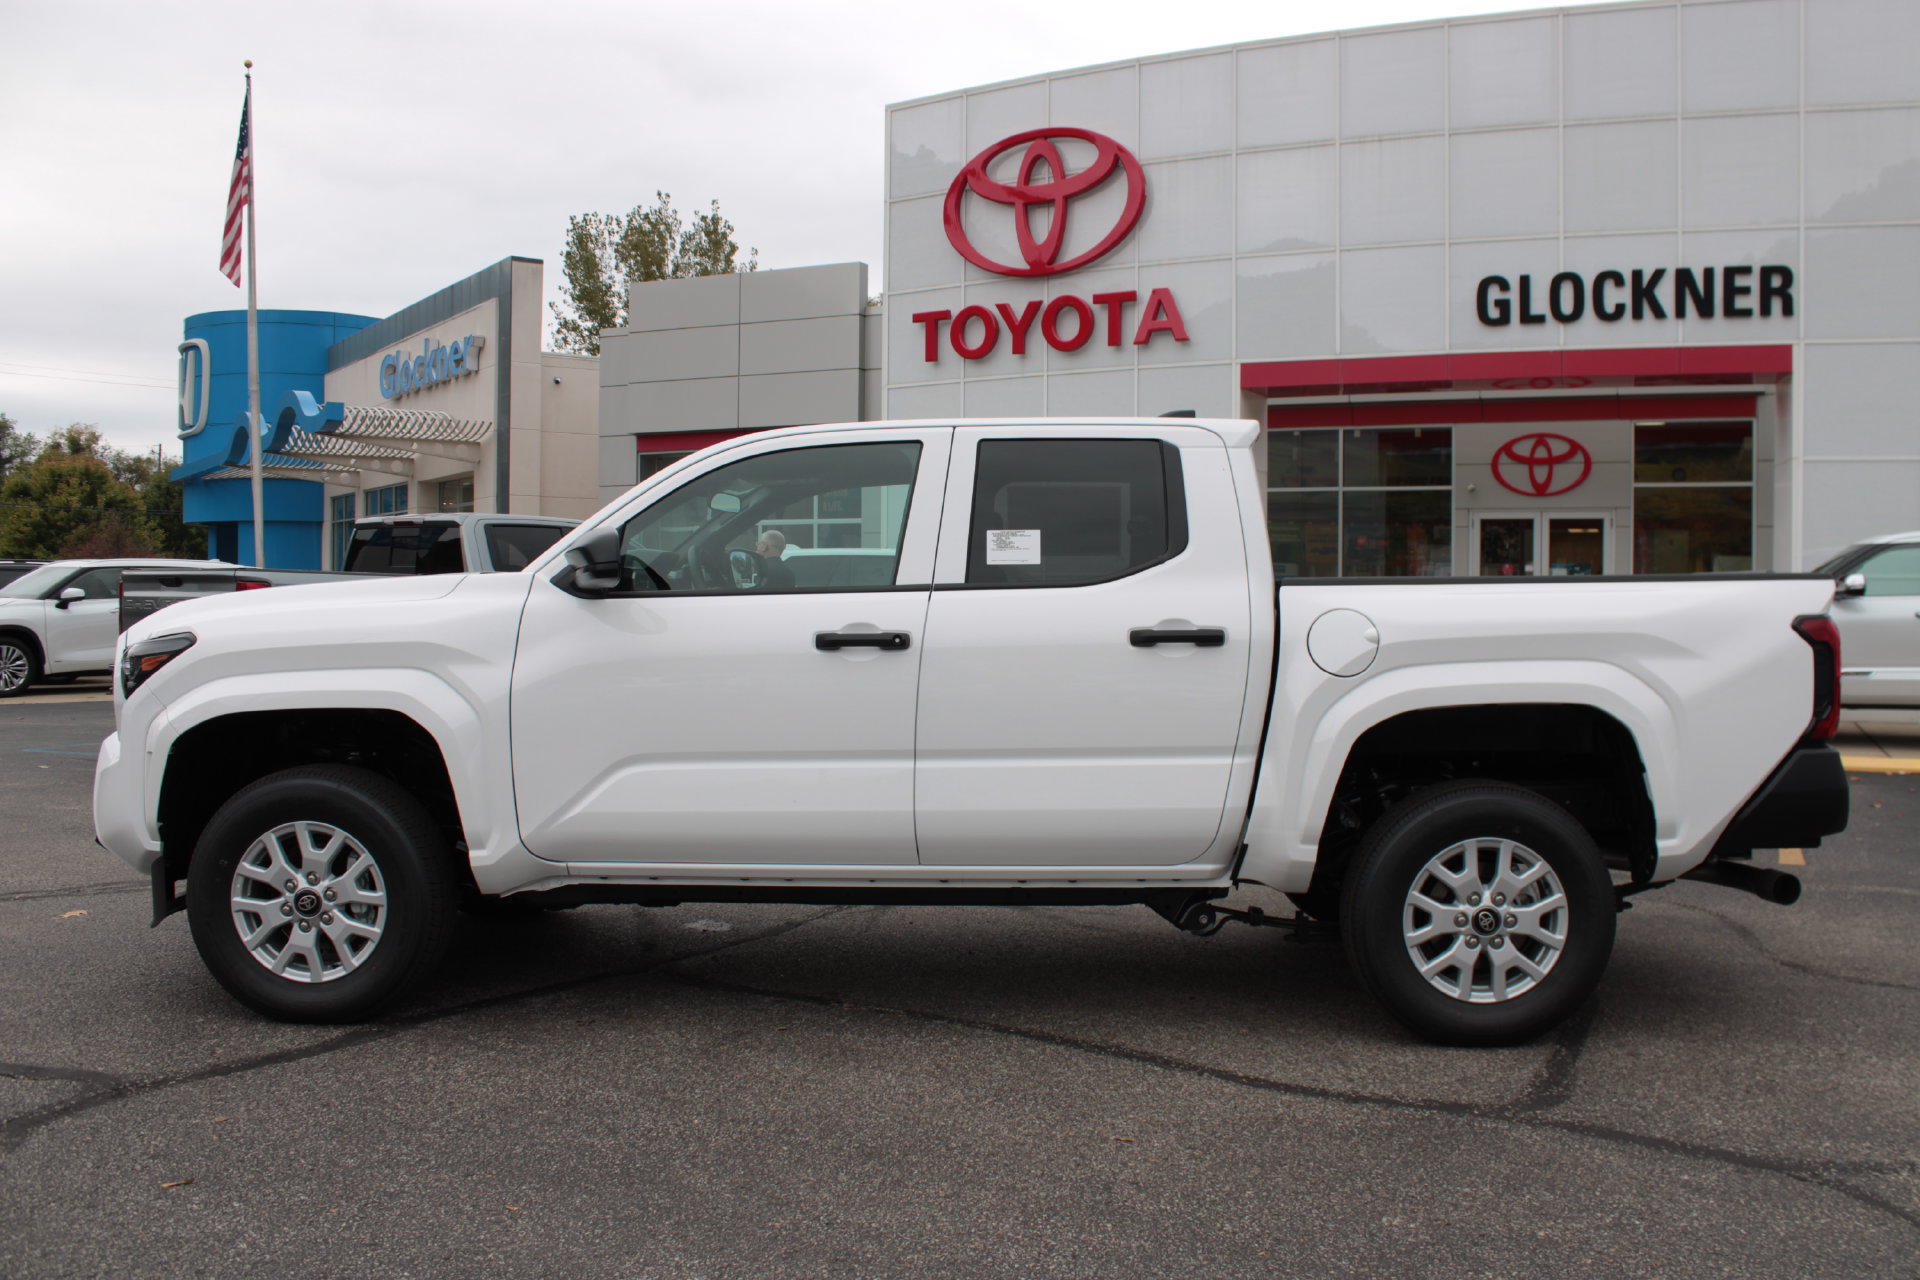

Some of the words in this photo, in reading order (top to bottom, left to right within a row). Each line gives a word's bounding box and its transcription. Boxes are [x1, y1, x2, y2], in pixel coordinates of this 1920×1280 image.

[912, 287, 1191, 363] TOYOTA
[1476, 265, 1795, 327] GLOCKNER
[379, 334, 483, 400] Glockner
